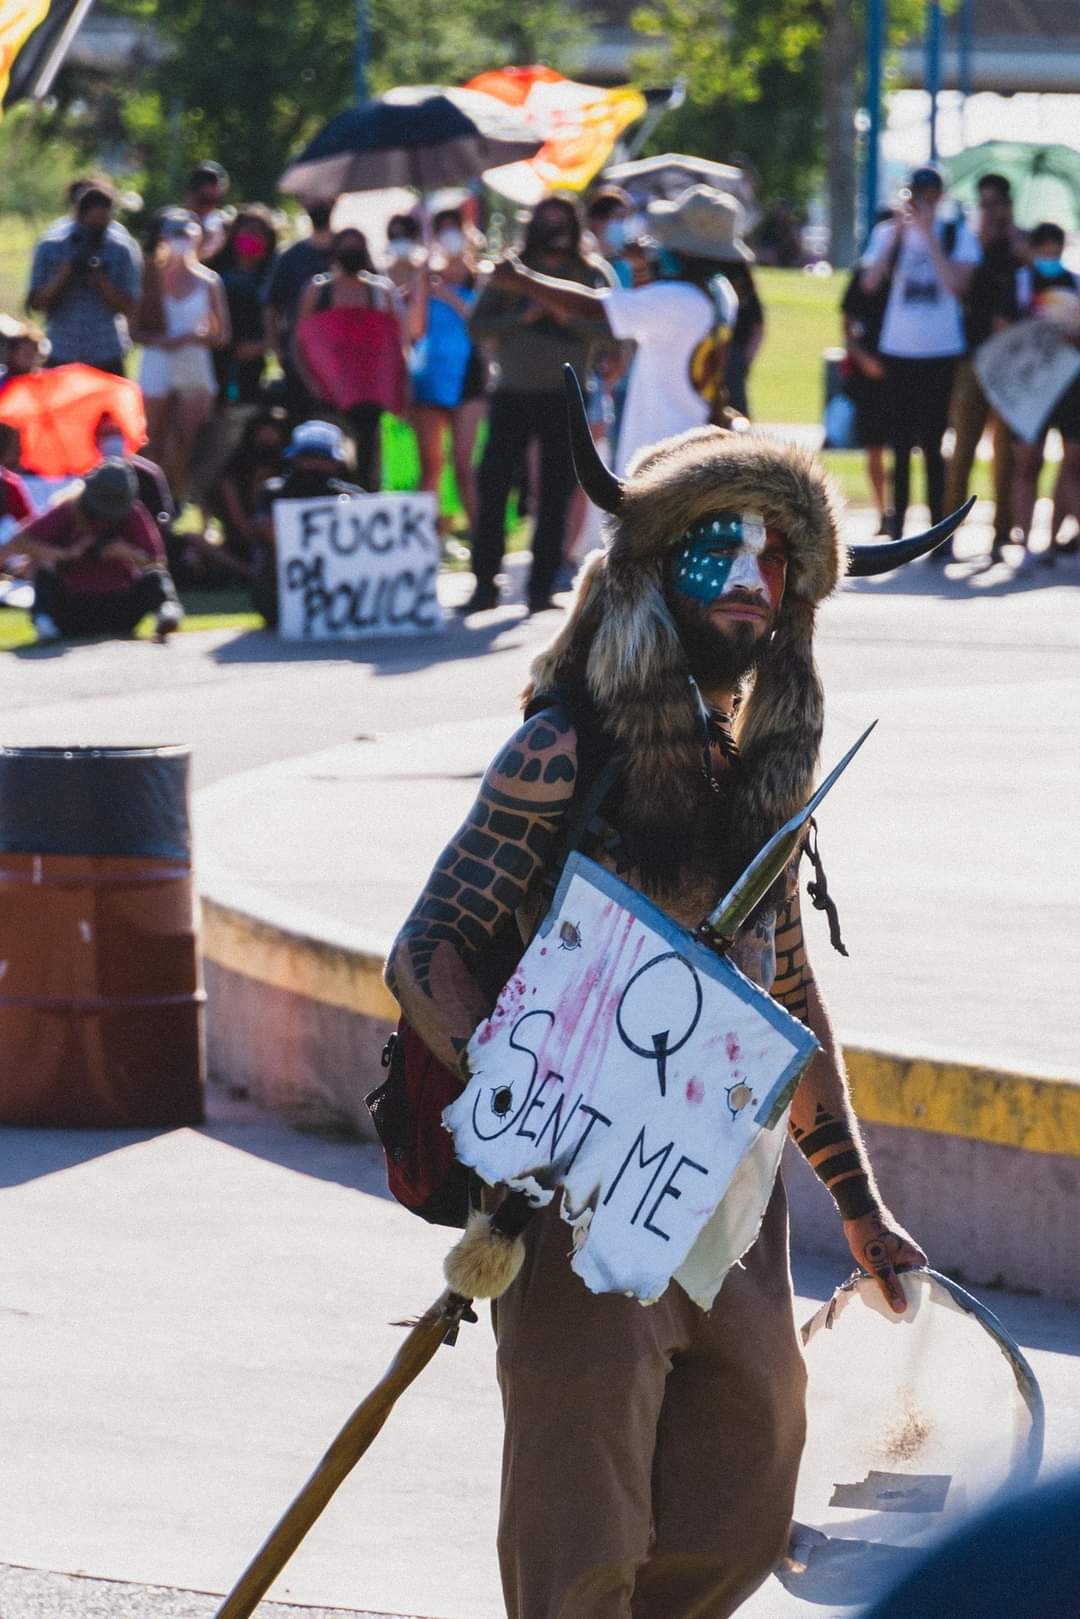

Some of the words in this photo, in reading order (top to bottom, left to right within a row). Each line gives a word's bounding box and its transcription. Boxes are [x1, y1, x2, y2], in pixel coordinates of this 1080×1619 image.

[301, 503, 432, 556] FUCK
[302, 564, 438, 634] POLICE
[616, 951, 703, 1097] Q
[472, 1009, 612, 1176] SENT
[603, 1124, 709, 1241] ME
